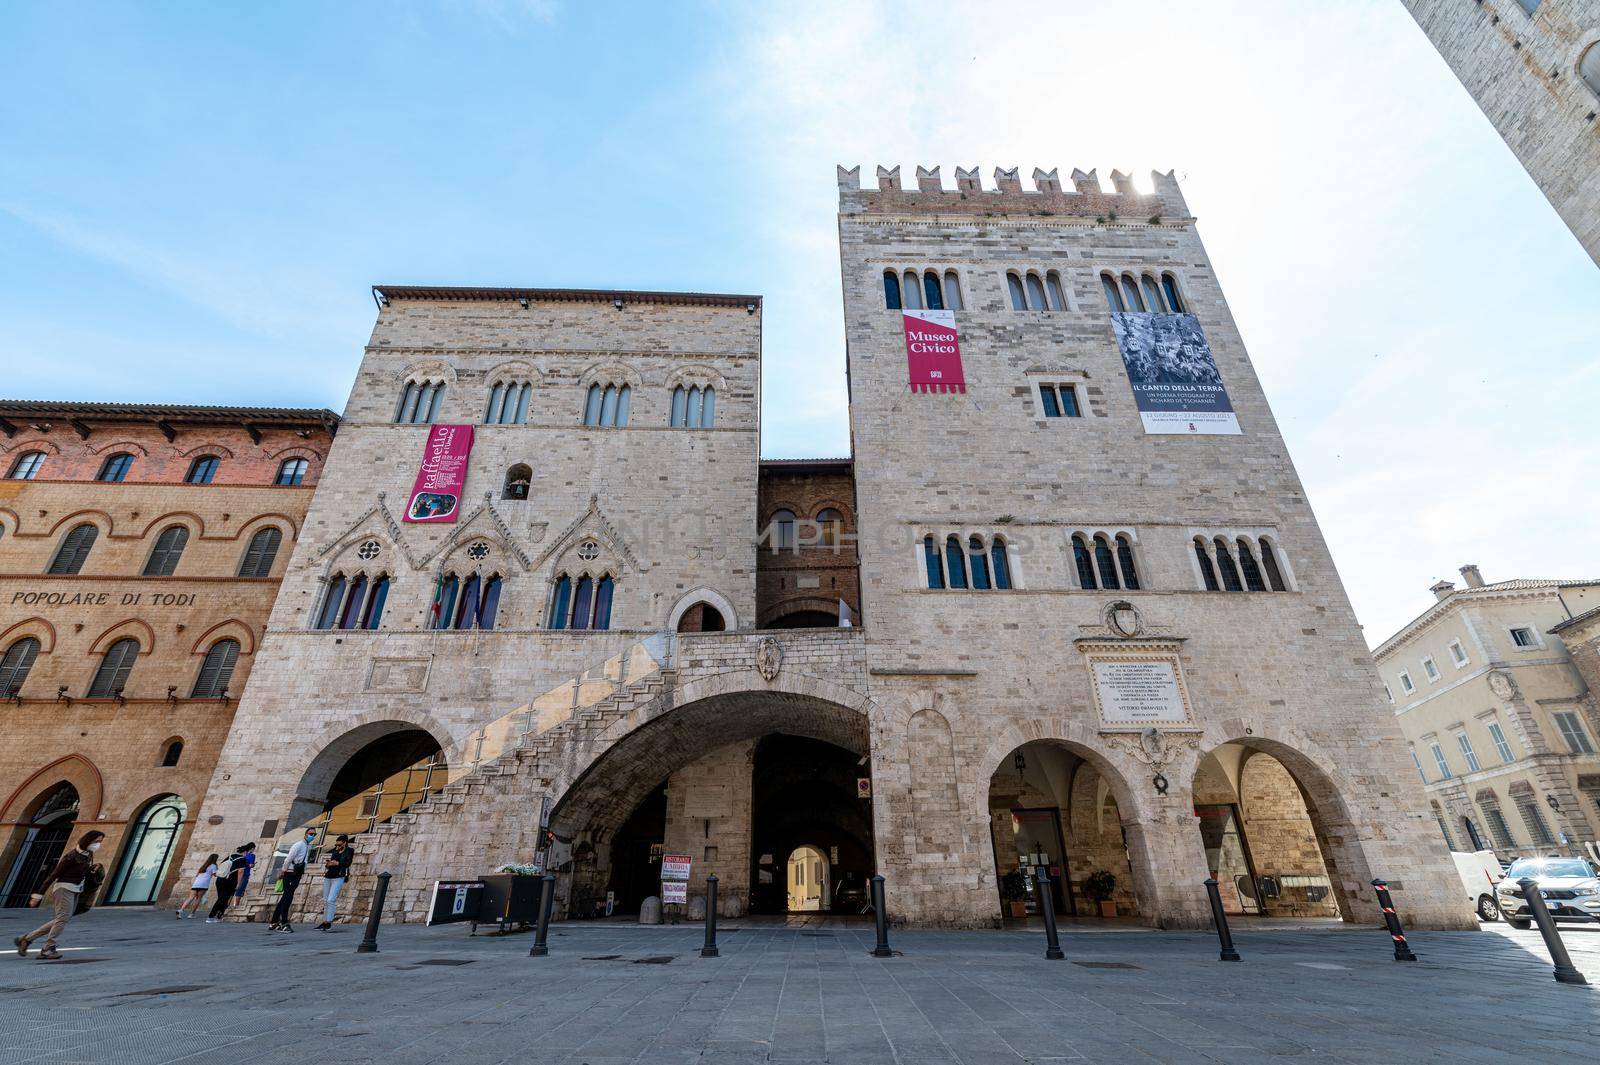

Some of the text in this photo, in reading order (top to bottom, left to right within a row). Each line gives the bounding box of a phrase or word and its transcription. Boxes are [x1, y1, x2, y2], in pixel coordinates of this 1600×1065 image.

[909, 331, 955, 342] Museo
[910, 342, 956, 353] Civico
[11, 591, 196, 606] POPOLARE DI TODI
